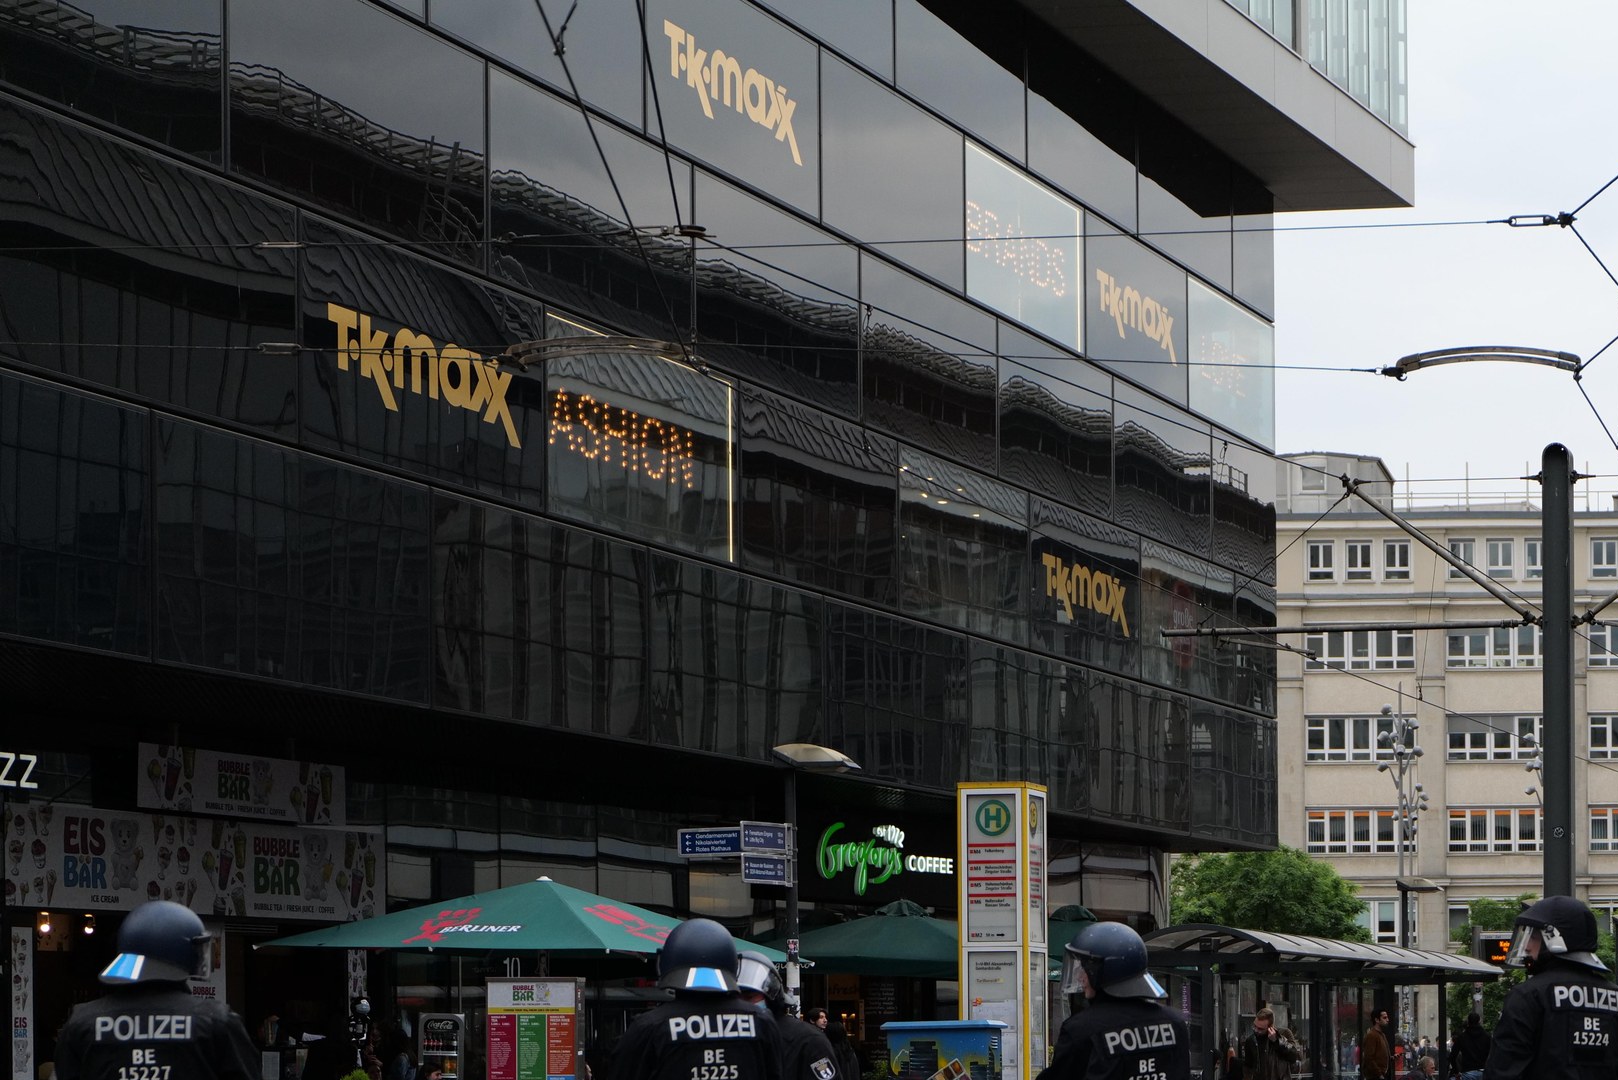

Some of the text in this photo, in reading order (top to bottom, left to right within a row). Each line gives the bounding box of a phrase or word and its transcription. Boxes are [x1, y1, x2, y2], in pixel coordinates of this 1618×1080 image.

[967, 199, 1065, 298] BRANDS
[549, 386, 693, 489] ASHION
[217, 759, 250, 775] BUBBLE
[217, 774, 250, 801] BÄR
[64, 816, 106, 856] EIS
[695, 832, 738, 840] Gendarmenmarkt
[253, 836, 300, 858] BUBBLE
[64, 855, 107, 889] BÄR
[906, 854, 954, 874] COFFEE
[253, 857, 300, 896] BÄR
[91, 895, 120, 904] ICE CREAM
[253, 902, 335, 914] BUBBLE TEA FRESH JUICE COFFEE
[439, 924, 522, 934] BERLINER
[512, 990, 535, 1002] BÄR
[14, 1017, 27, 1028] EIS
[95, 1015, 192, 1041] POLIZEI
[669, 1013, 756, 1041] POLIZEI
[1583, 1016, 1601, 1031] BE
[1104, 1023, 1177, 1055] POLIZEI
[1573, 1031, 1610, 1046] 15224
[131, 1048, 156, 1065] BE
[704, 1049, 725, 1065] BE
[690, 1065, 739, 1080] 15225
[1138, 1058, 1156, 1074] BE
